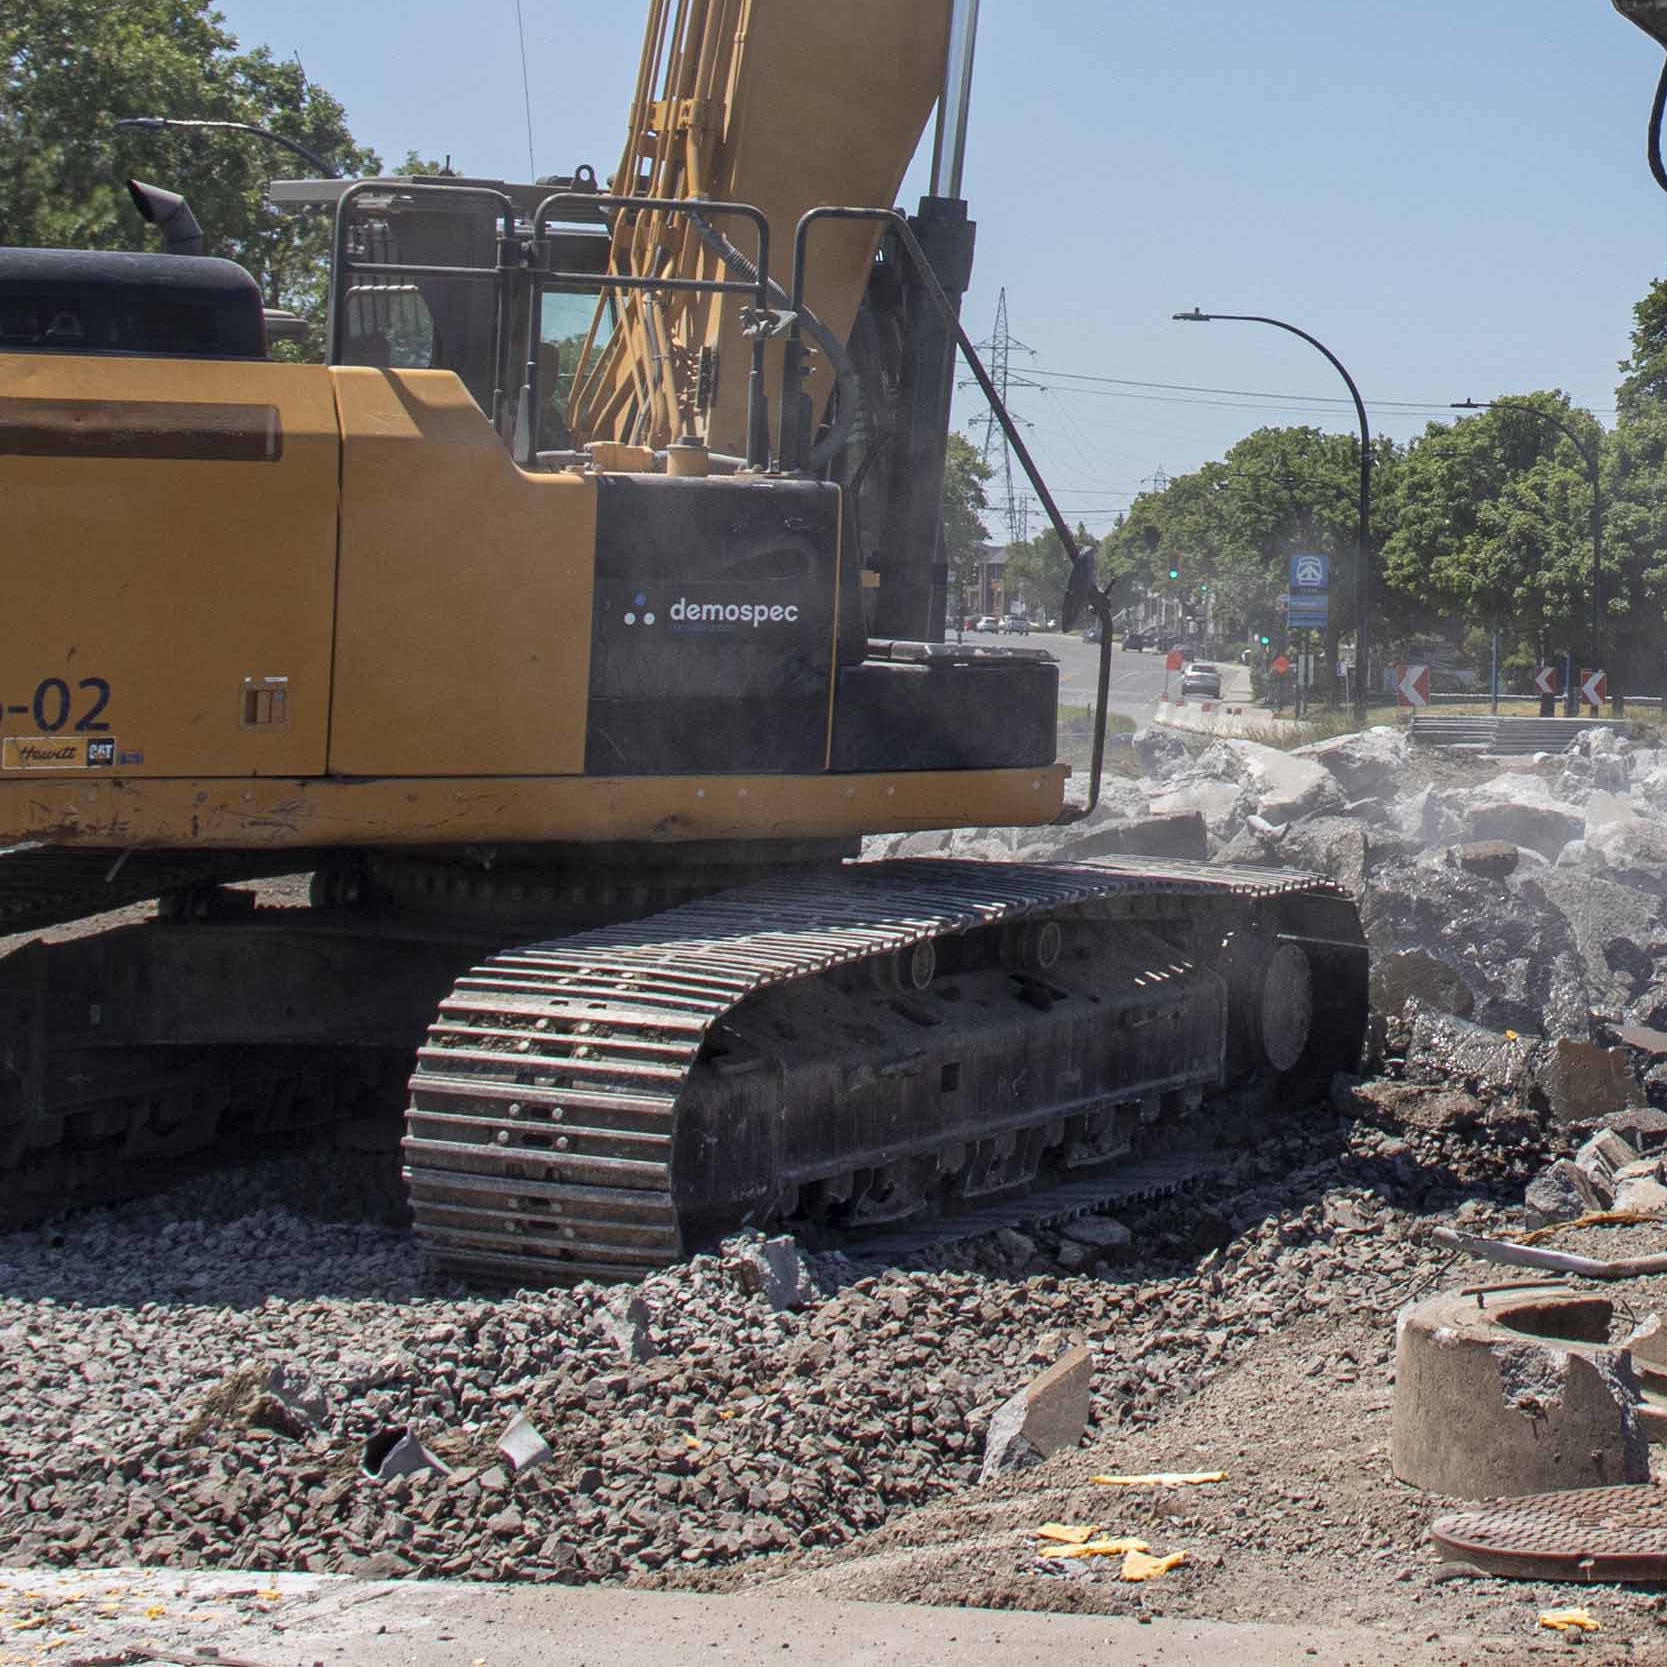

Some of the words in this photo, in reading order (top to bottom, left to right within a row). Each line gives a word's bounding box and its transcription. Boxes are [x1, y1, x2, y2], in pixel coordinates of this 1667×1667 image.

[669, 597, 799, 628] demospec
[0, 676, 112, 733] -02
[88, 743, 114, 760] CAT
